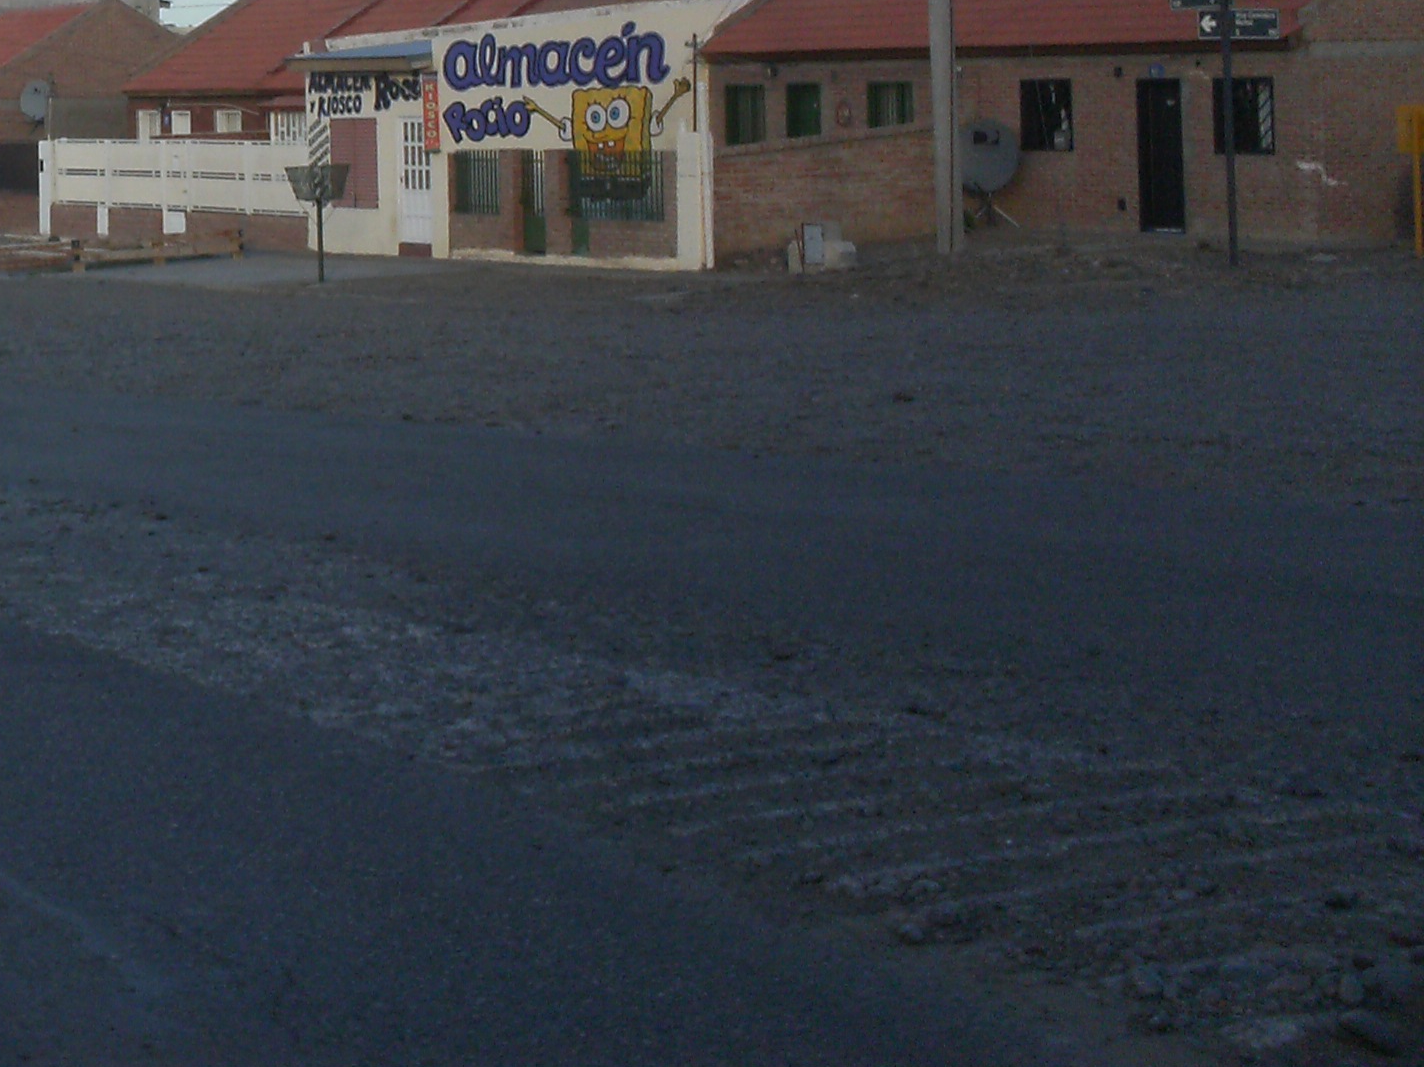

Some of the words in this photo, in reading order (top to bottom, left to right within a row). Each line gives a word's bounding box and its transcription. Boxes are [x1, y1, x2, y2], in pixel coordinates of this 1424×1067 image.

[443, 21, 671, 90] almacén
[317, 95, 362, 117] KIOSCO
[424, 83, 437, 138] KIOSCO
